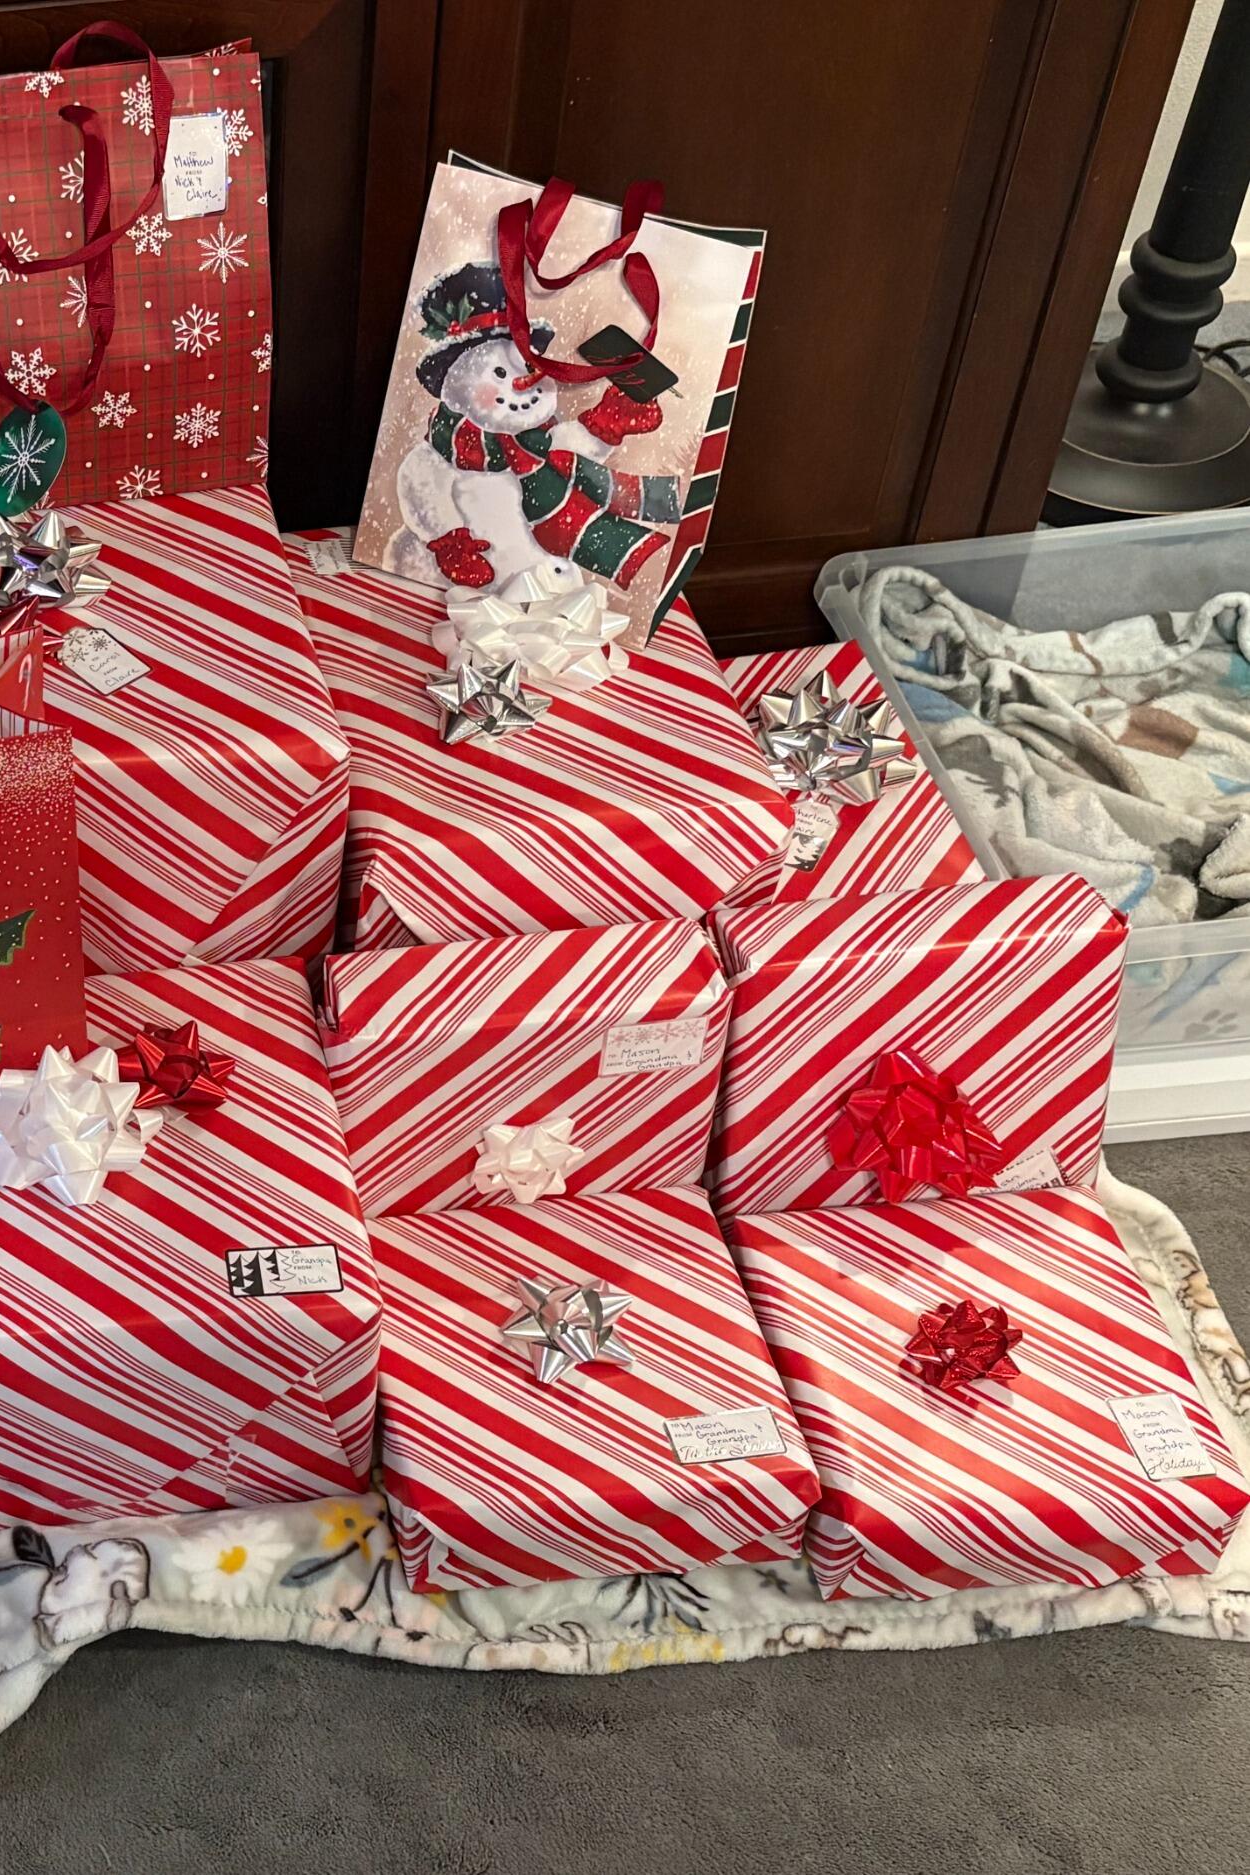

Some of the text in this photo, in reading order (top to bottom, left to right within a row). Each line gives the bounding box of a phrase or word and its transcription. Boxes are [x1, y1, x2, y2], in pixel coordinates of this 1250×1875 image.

[173, 155, 214, 168] Matthew
[186, 189, 218, 201] Claire
[1121, 1409, 1168, 1420] Mason
